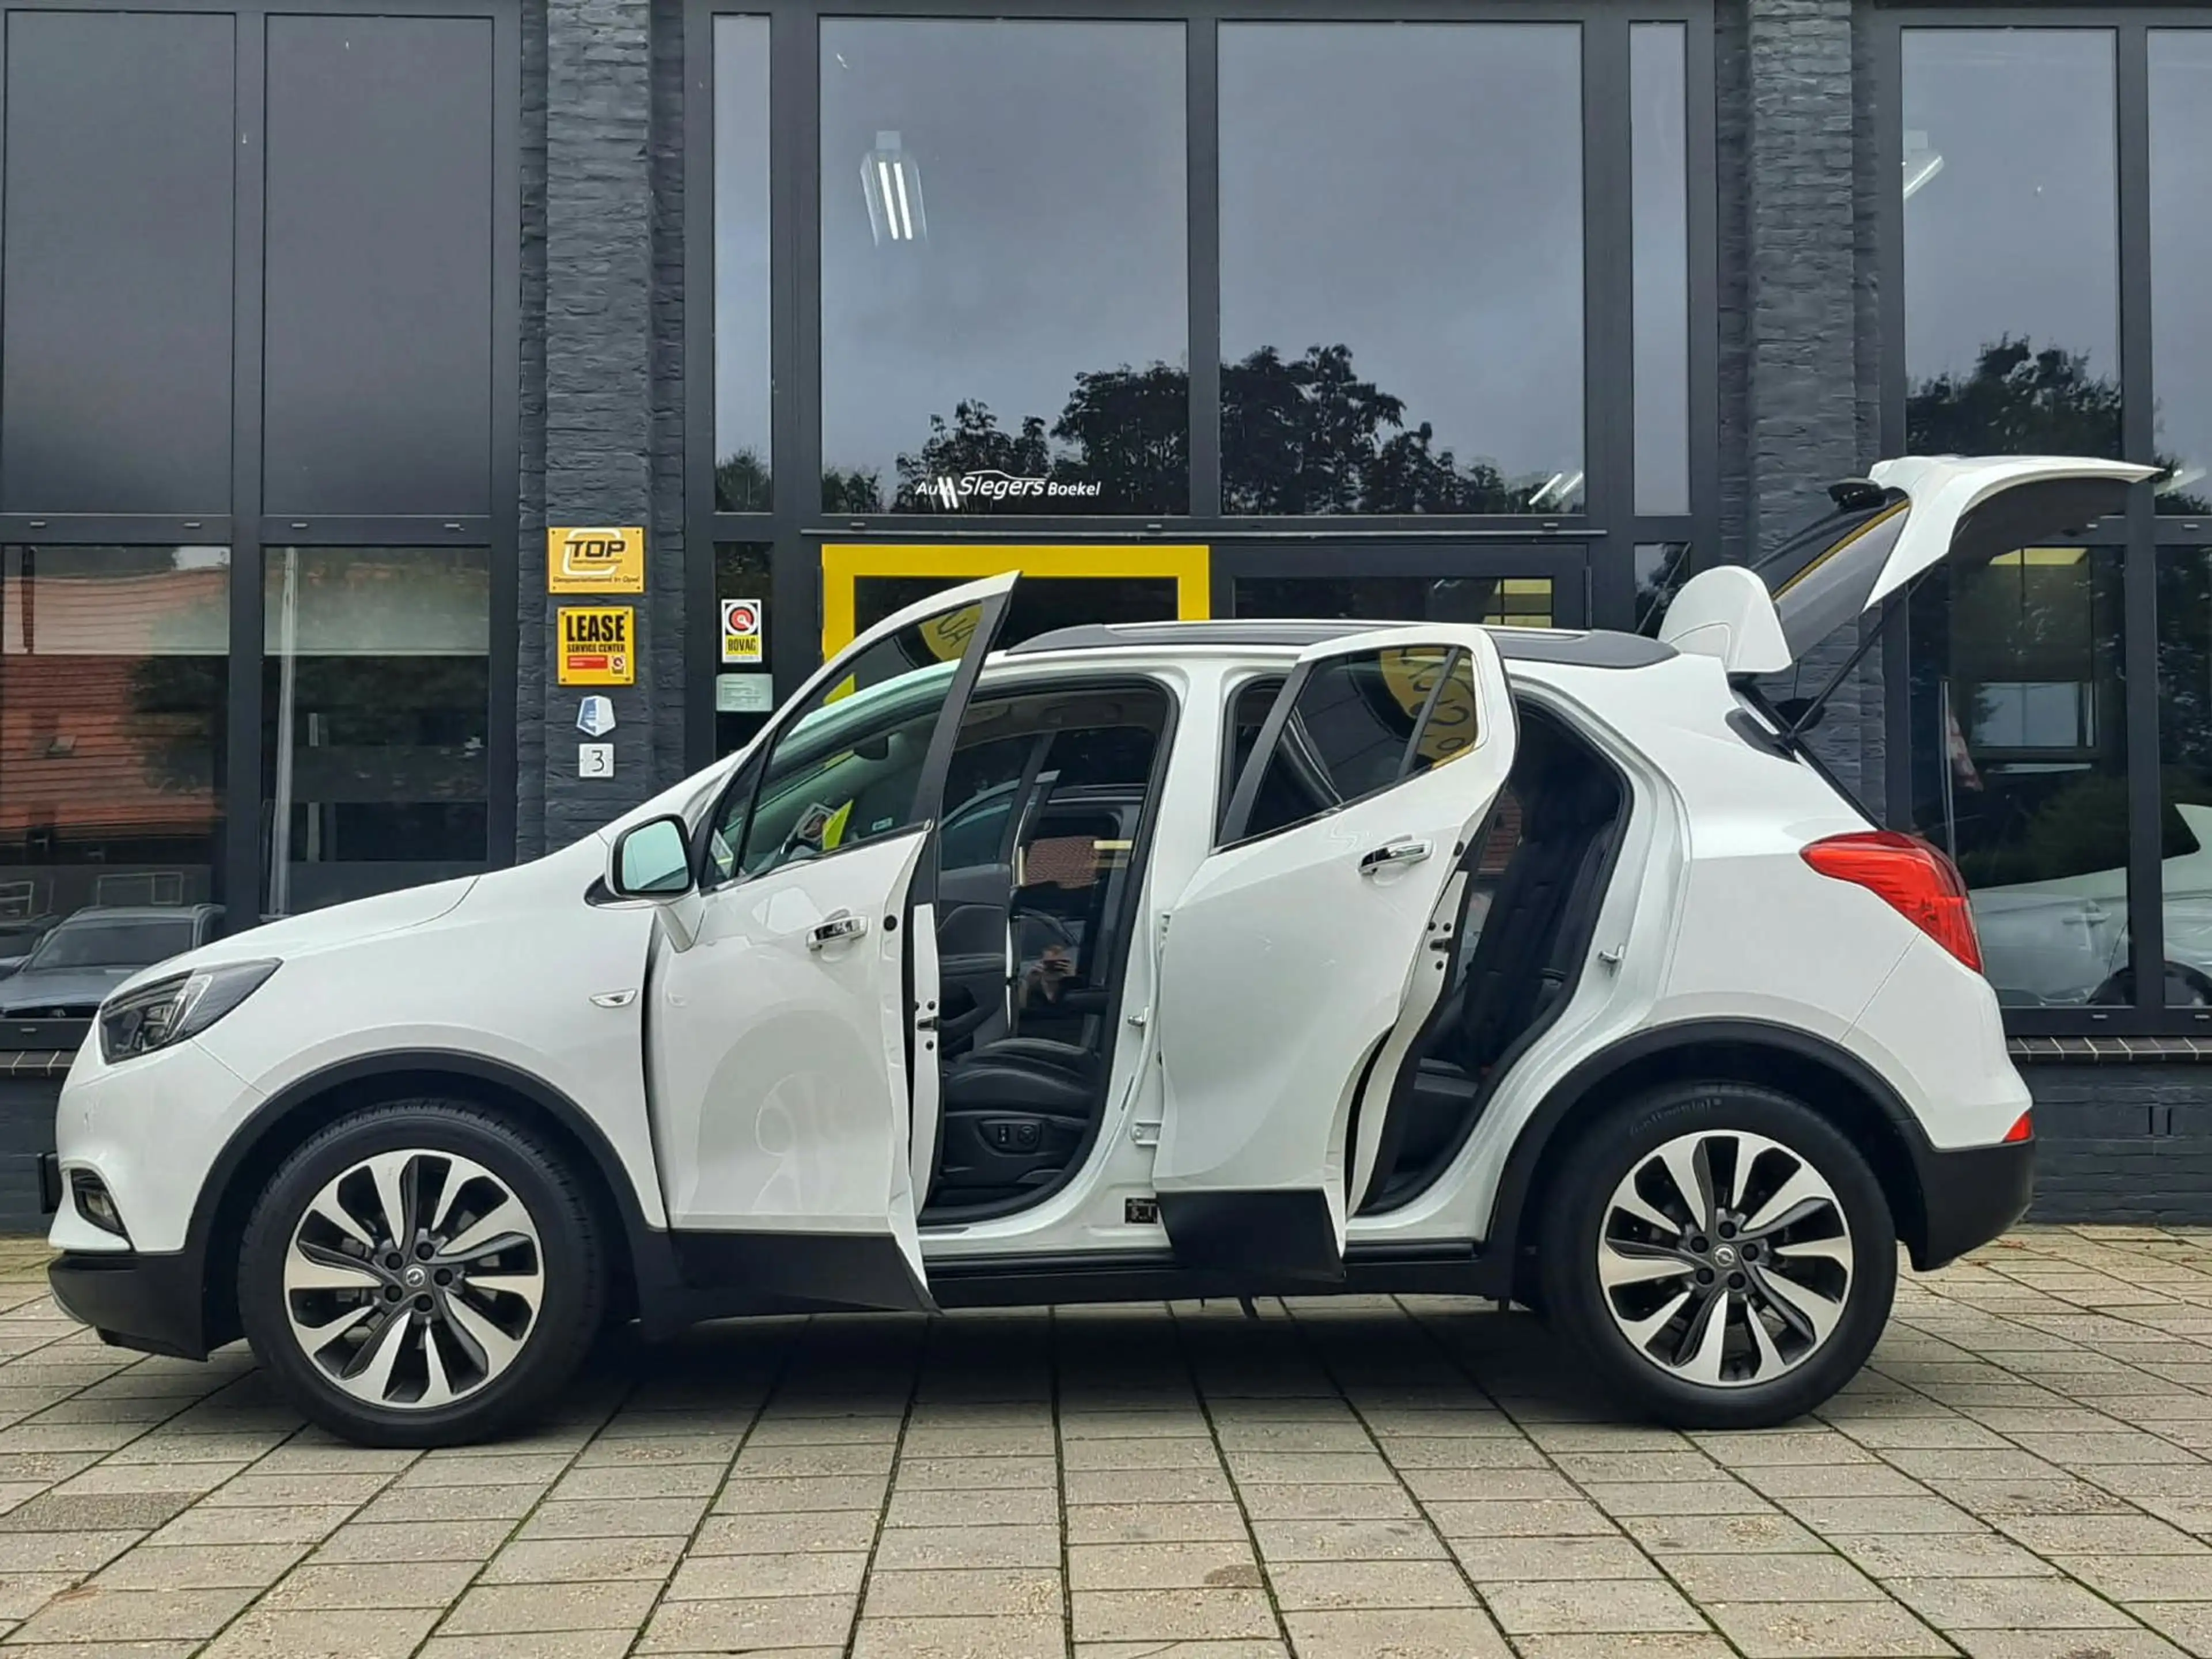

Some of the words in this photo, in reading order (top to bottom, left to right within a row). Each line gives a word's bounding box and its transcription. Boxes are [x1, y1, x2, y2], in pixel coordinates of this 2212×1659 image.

[957, 476, 1045, 500] Slegers
[1047, 482, 1101, 496] Boekel
[564, 540, 626, 557] TOP
[566, 615, 625, 642] LEASE
[567, 643, 596, 653] SERVICE
[599, 643, 625, 653] CENTER
[592, 750, 604, 771] 3
